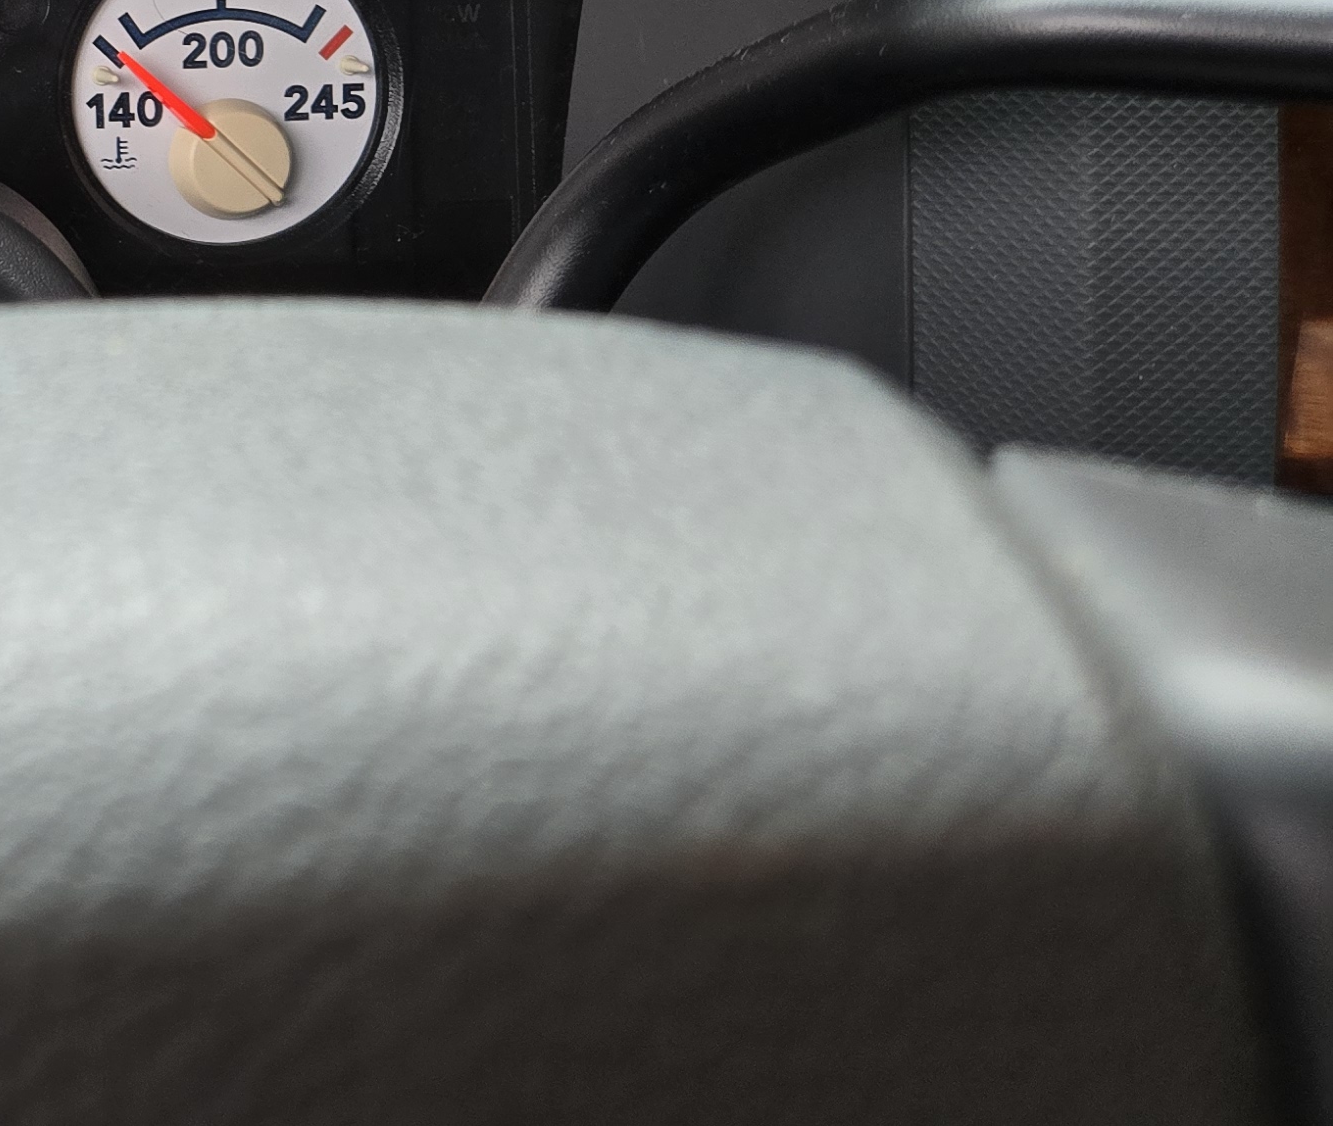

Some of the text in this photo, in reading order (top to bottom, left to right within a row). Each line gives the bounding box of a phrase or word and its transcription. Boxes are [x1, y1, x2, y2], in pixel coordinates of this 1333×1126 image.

[182, 30, 264, 70] 200
[85, 91, 163, 129] 140
[283, 82, 366, 122] 245
